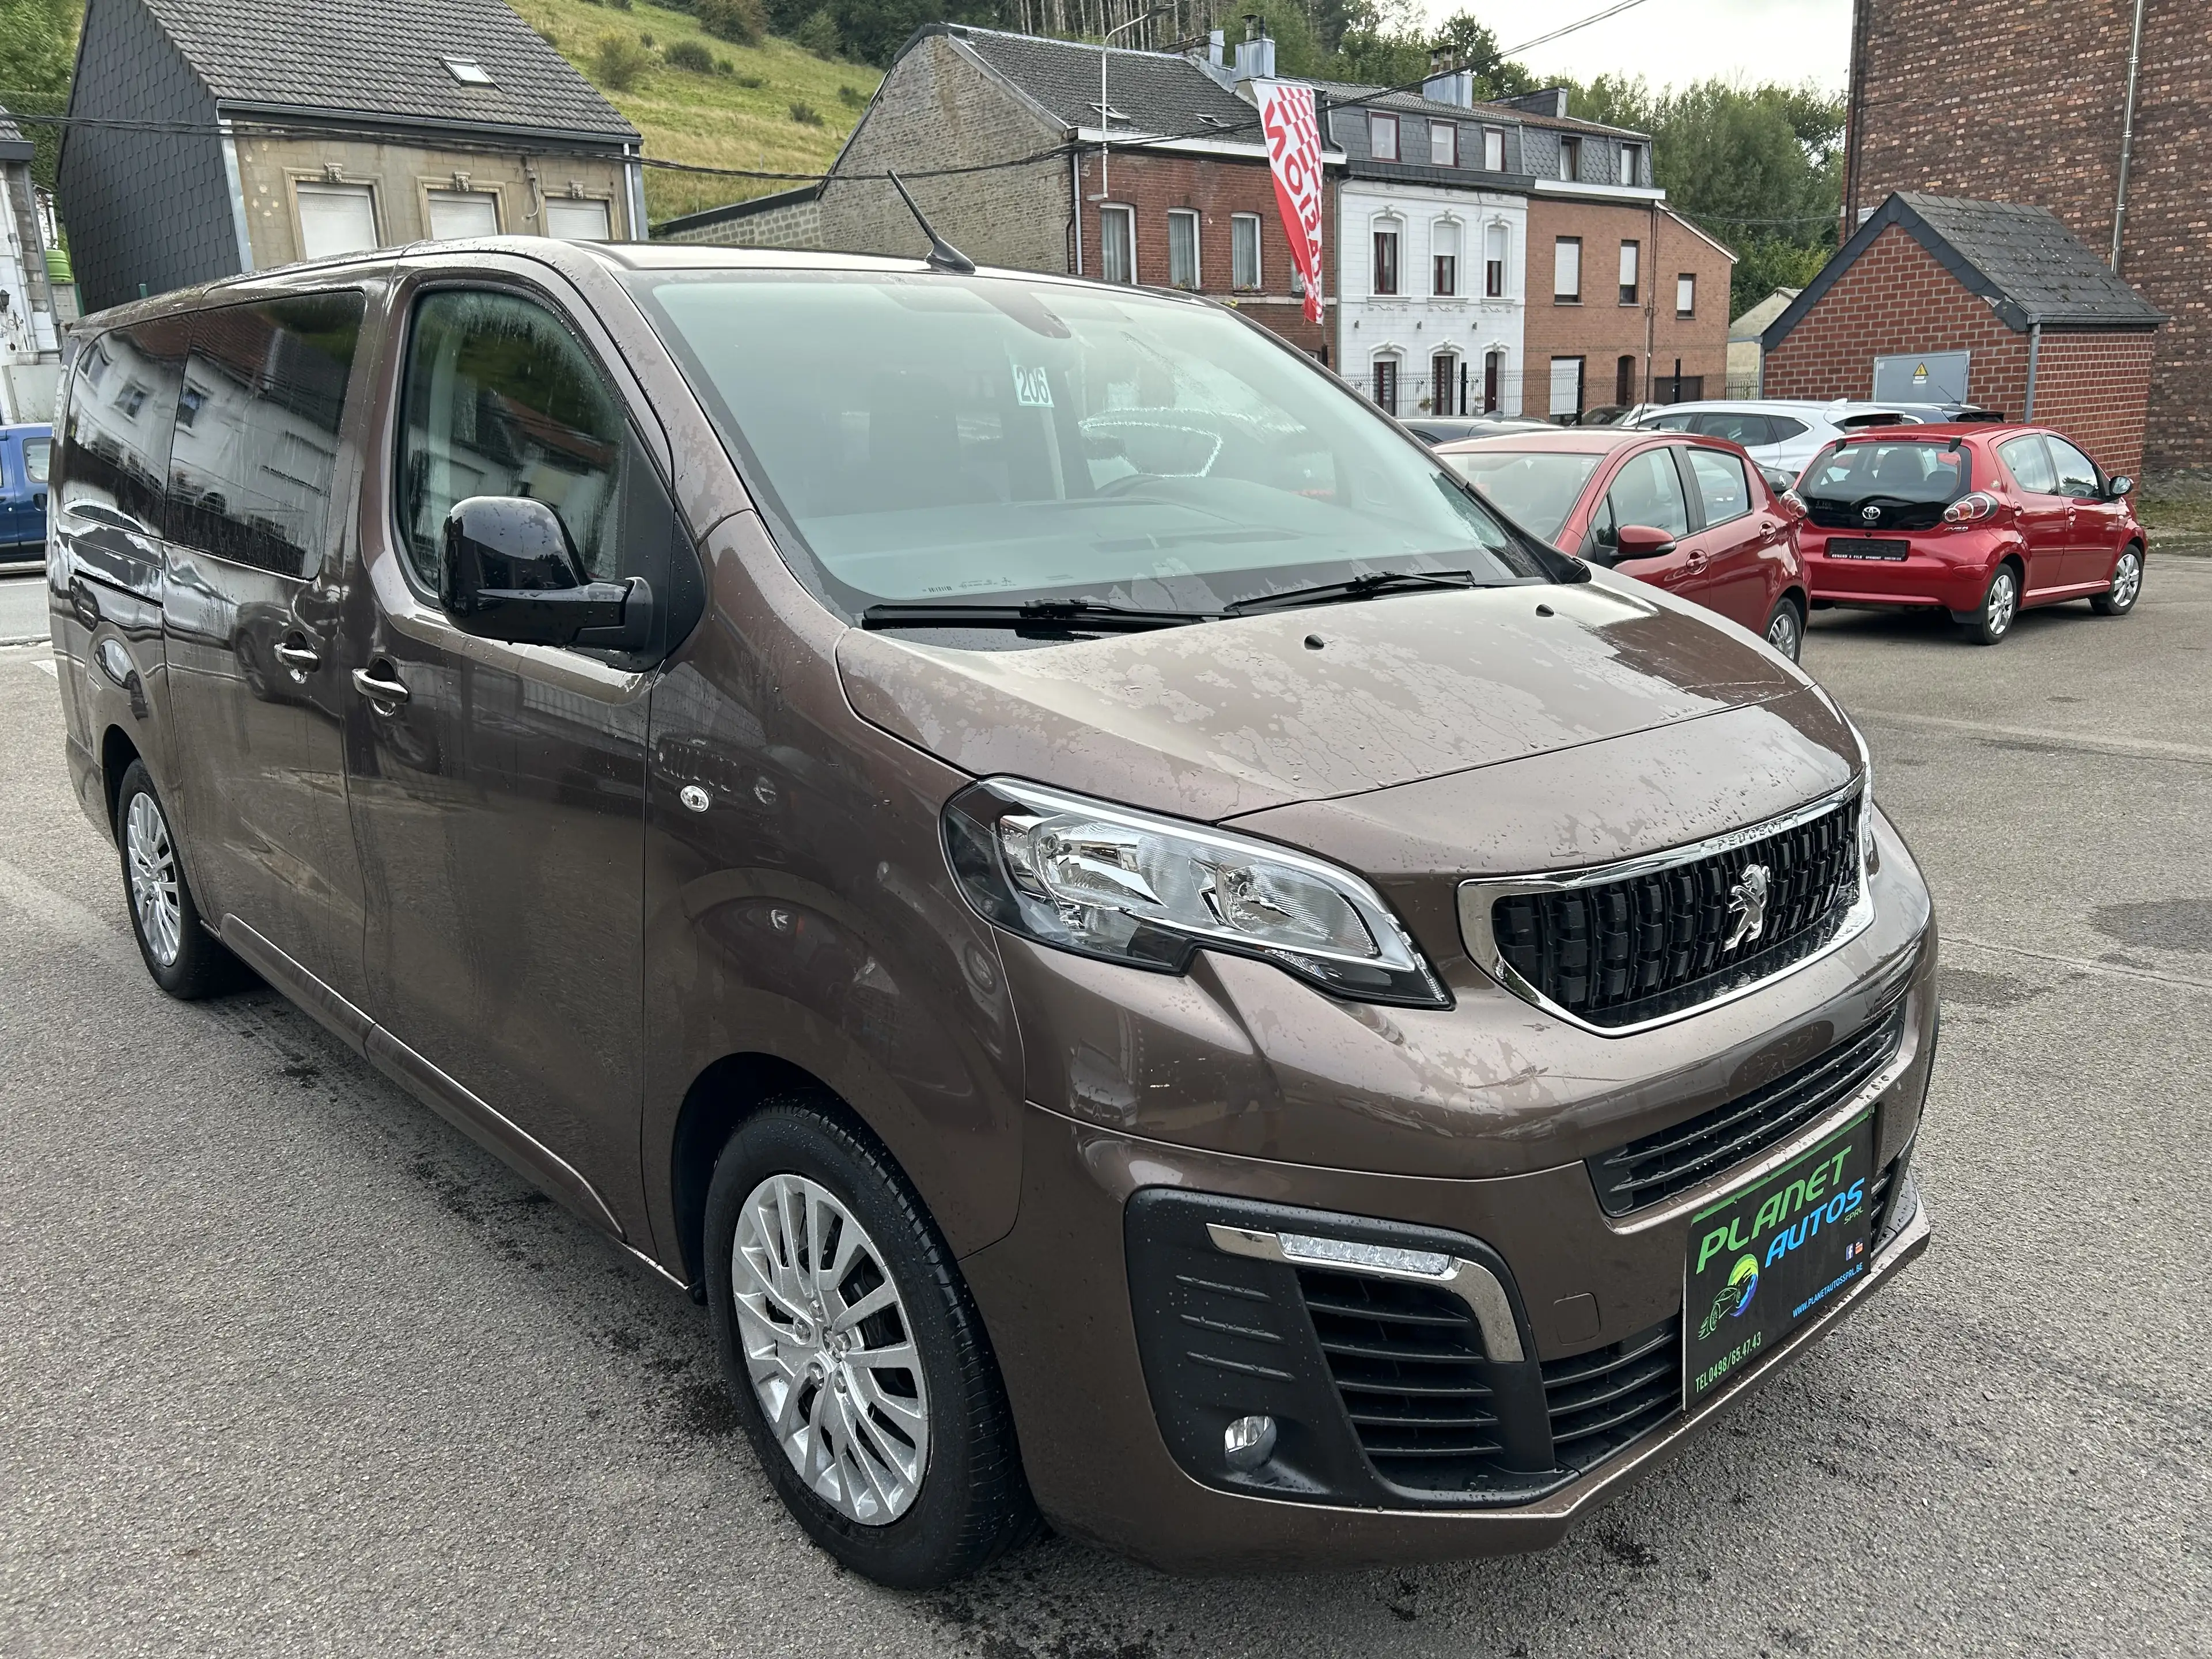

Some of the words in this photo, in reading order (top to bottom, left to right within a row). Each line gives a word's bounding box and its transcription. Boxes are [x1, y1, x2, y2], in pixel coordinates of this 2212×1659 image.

[1016, 366, 1049, 404] 206
[1717, 820, 1782, 850] PEUGEOT
[1696, 1145, 1853, 1275] PLANET
[1765, 1177, 1865, 1268] AUTOS
[1843, 1206, 1864, 1225] SPRL
